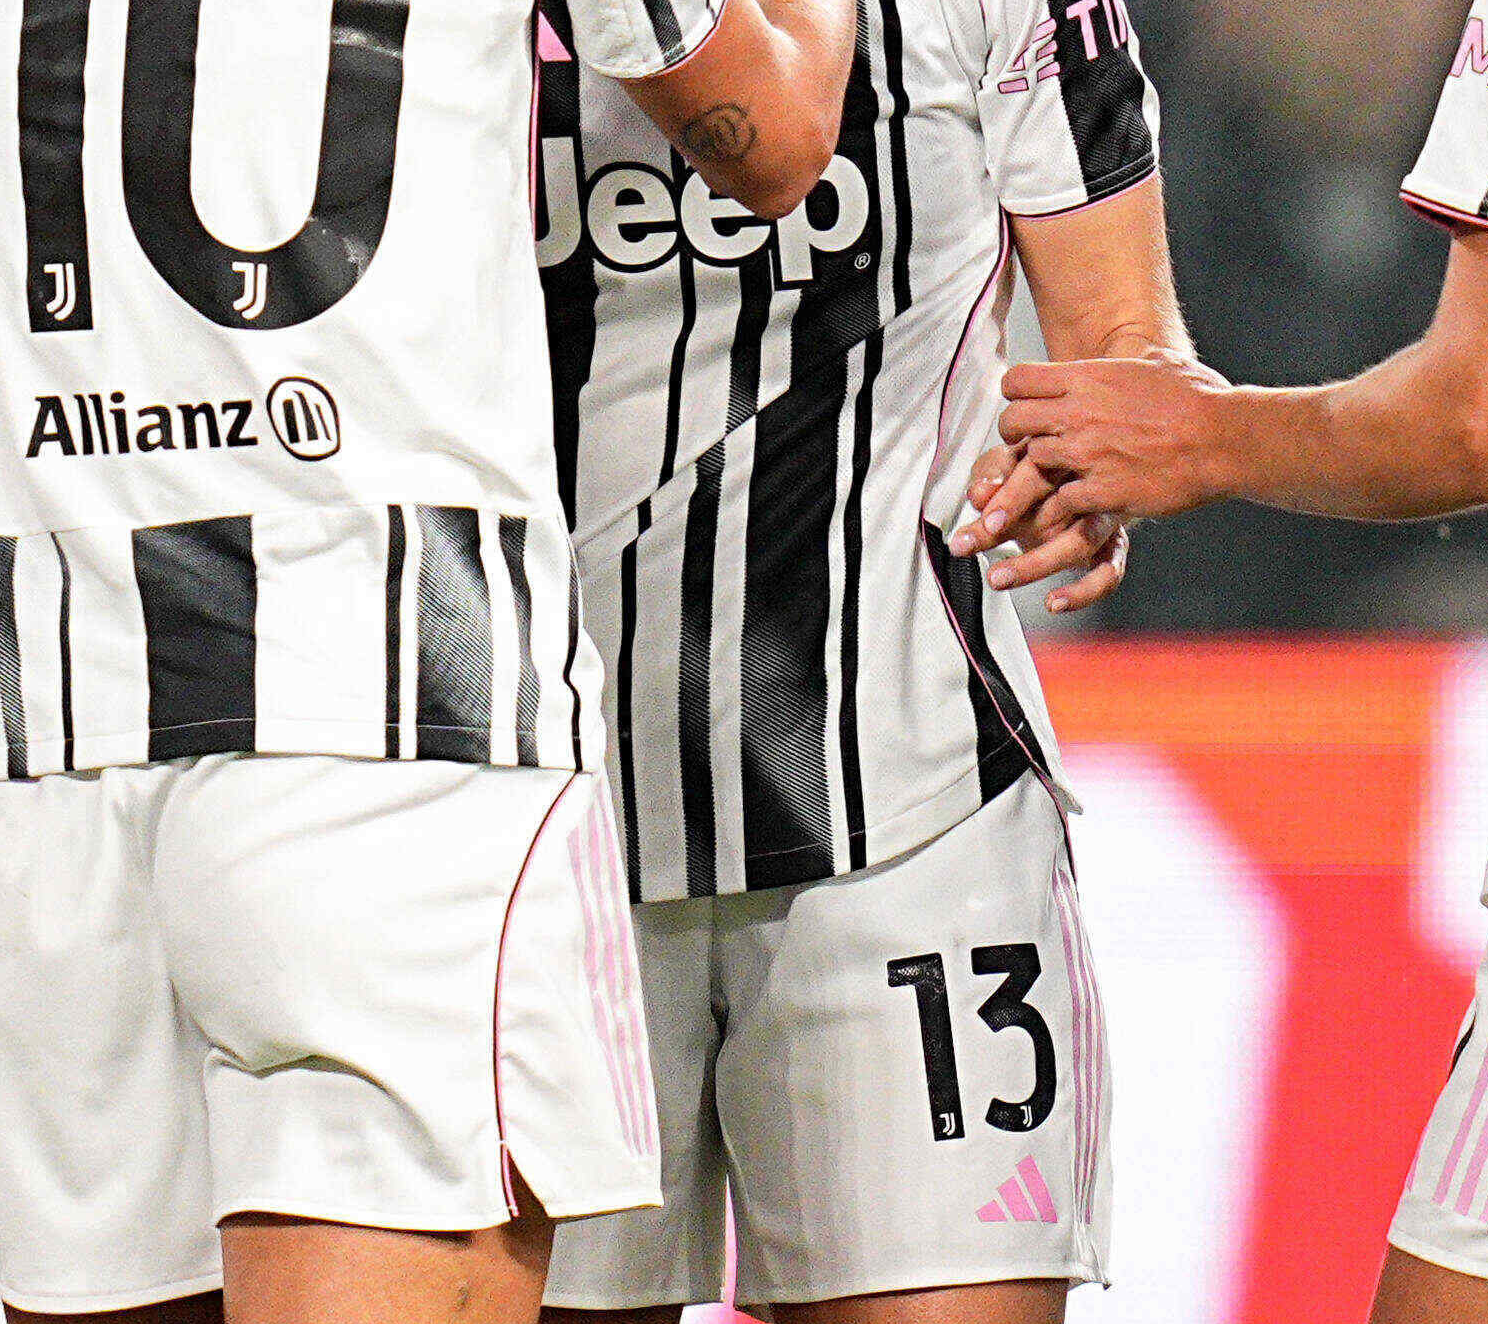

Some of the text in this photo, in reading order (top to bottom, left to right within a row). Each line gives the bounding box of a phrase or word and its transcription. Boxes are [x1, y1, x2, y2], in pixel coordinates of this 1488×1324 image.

[535, 135, 872, 283] Jeep
[24, 391, 260, 458] Allianz
[886, 941, 1058, 1142] 13
